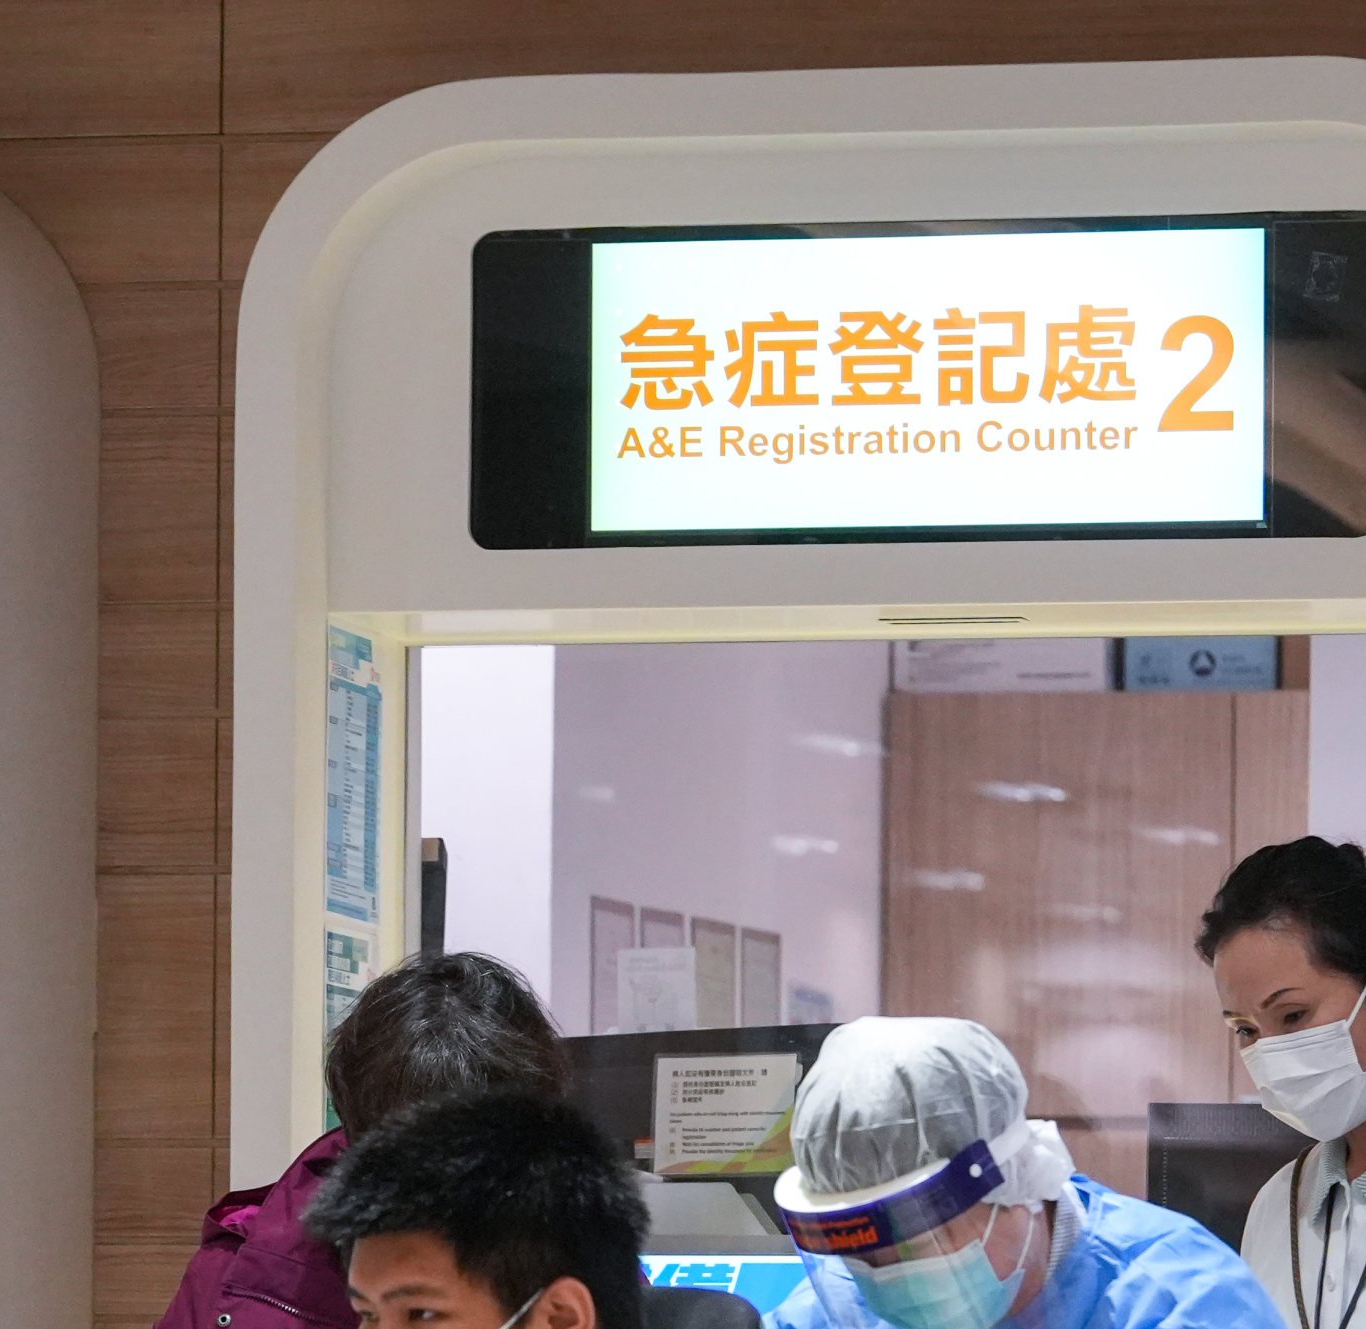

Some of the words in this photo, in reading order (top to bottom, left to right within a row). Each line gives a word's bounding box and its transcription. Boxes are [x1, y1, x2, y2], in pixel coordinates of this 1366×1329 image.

[620, 304, 1138, 411] 急症登記處
[1157, 315, 1237, 432] 2
[617, 426, 703, 459] A&E
[719, 424, 961, 465] Registration
[976, 418, 1139, 452] Counter
